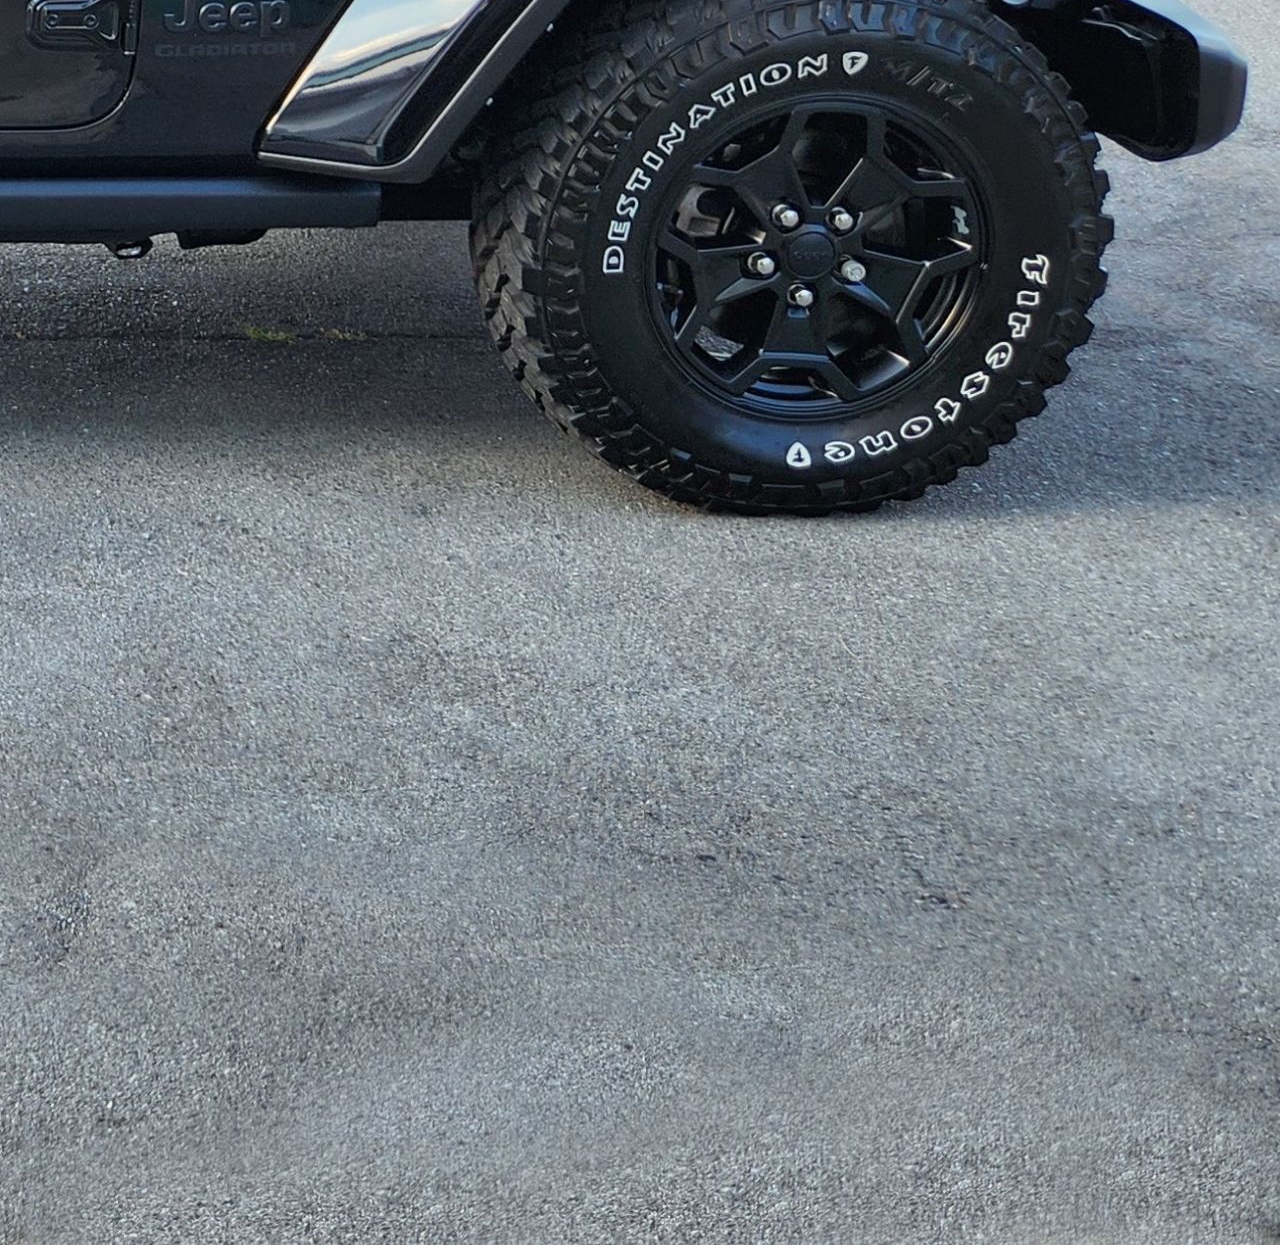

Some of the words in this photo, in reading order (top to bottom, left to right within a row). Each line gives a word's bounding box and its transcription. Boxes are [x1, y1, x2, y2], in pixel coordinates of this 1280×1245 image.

[154, 42, 296, 57] GLADIATOR
[602, 53, 828, 274] DESTINATION
[824, 254, 1050, 462] Firestone
